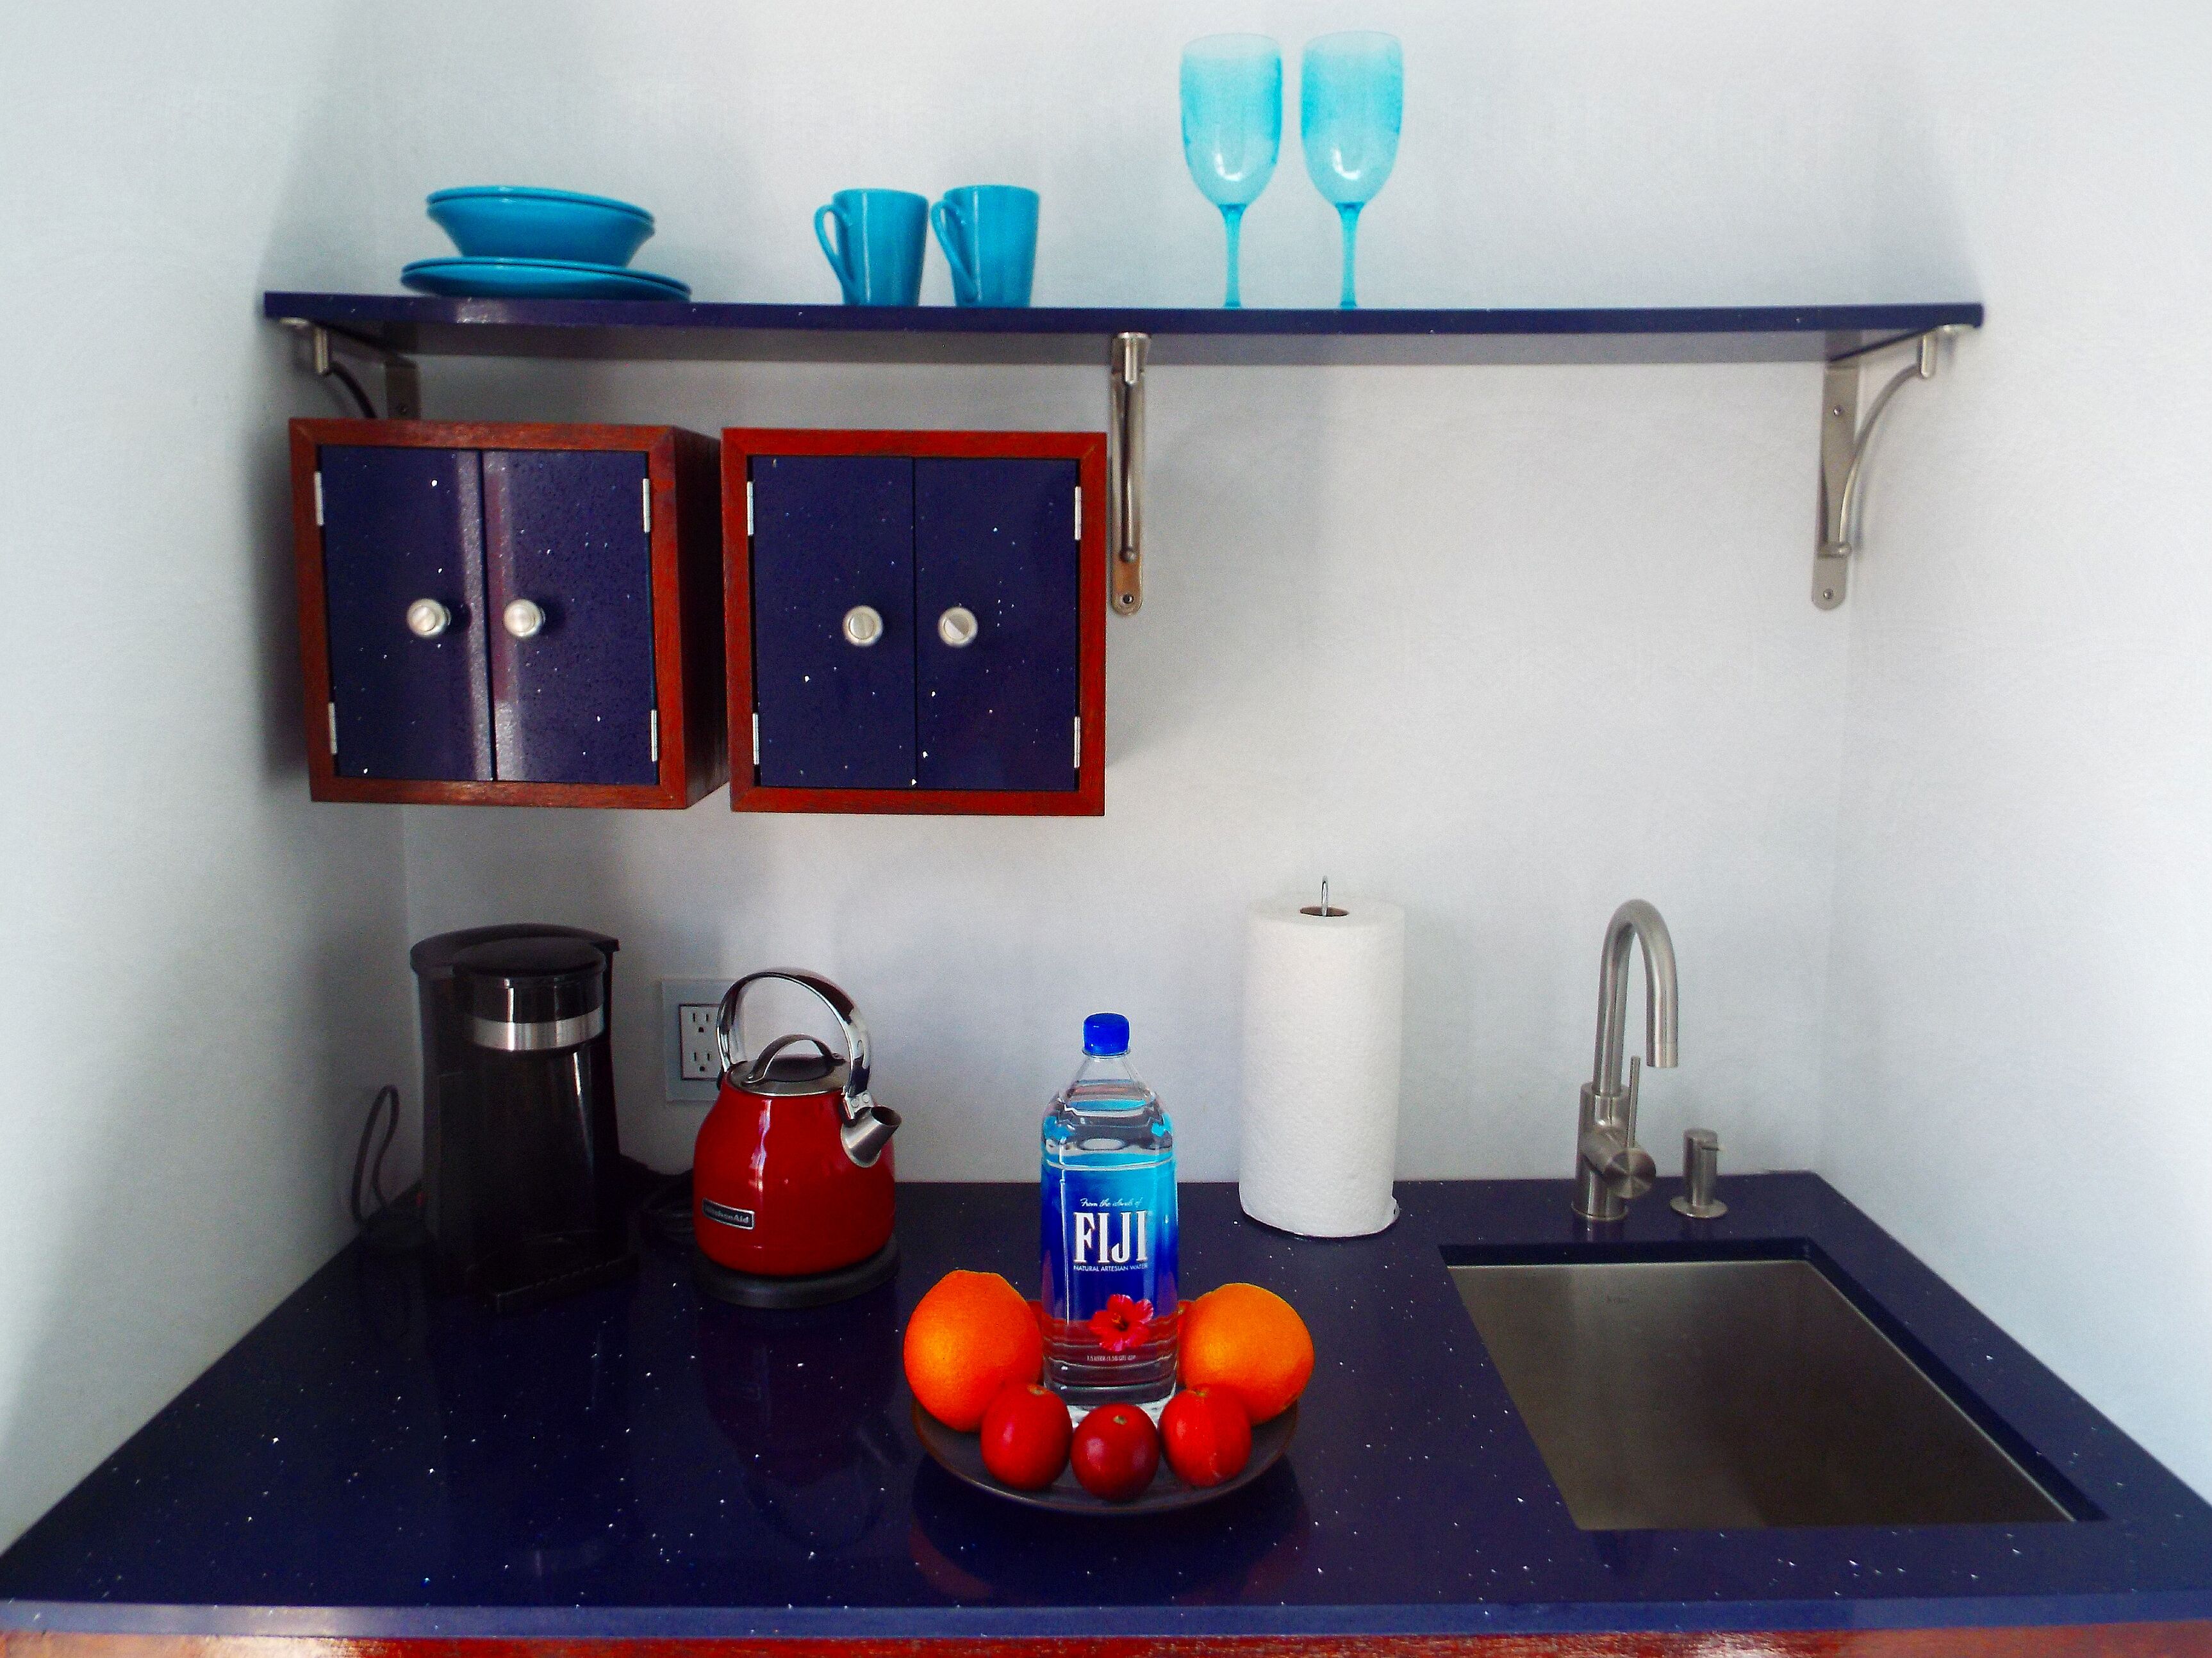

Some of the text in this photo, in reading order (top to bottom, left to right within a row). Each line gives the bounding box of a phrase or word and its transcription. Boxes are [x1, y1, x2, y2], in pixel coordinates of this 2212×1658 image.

[1080, 1198, 1098, 1207] From
[1099, 1198, 1110, 1207] the
[705, 1204, 749, 1224] henAid
[1073, 1210, 1148, 1263] FIJI
